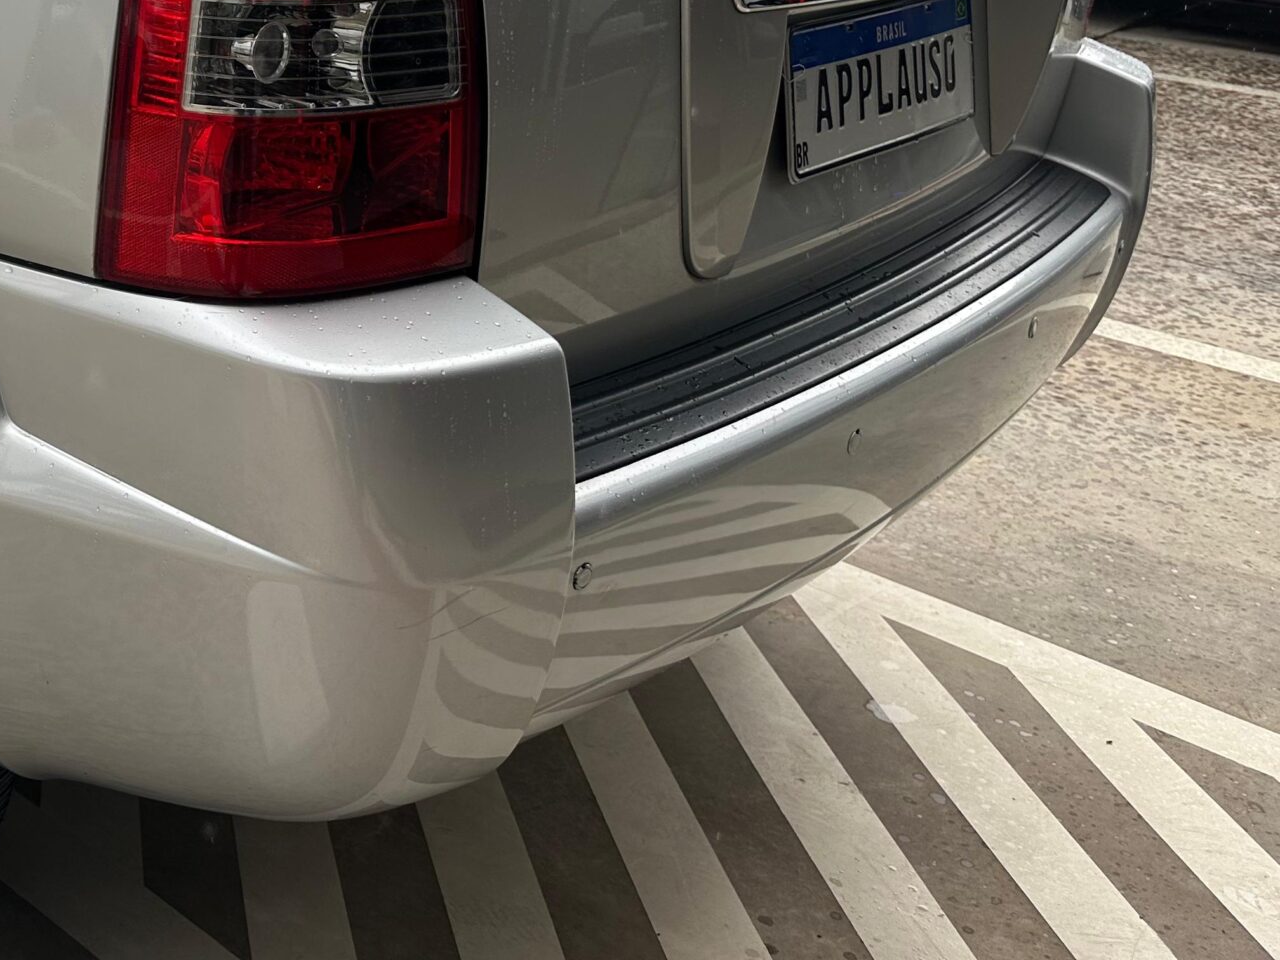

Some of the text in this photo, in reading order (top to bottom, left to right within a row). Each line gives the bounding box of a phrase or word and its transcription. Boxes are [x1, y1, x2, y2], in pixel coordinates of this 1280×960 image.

[876, 21, 907, 43] BRASIL
[816, 35, 956, 134] APPLAUSO
[796, 141, 809, 168] BR
